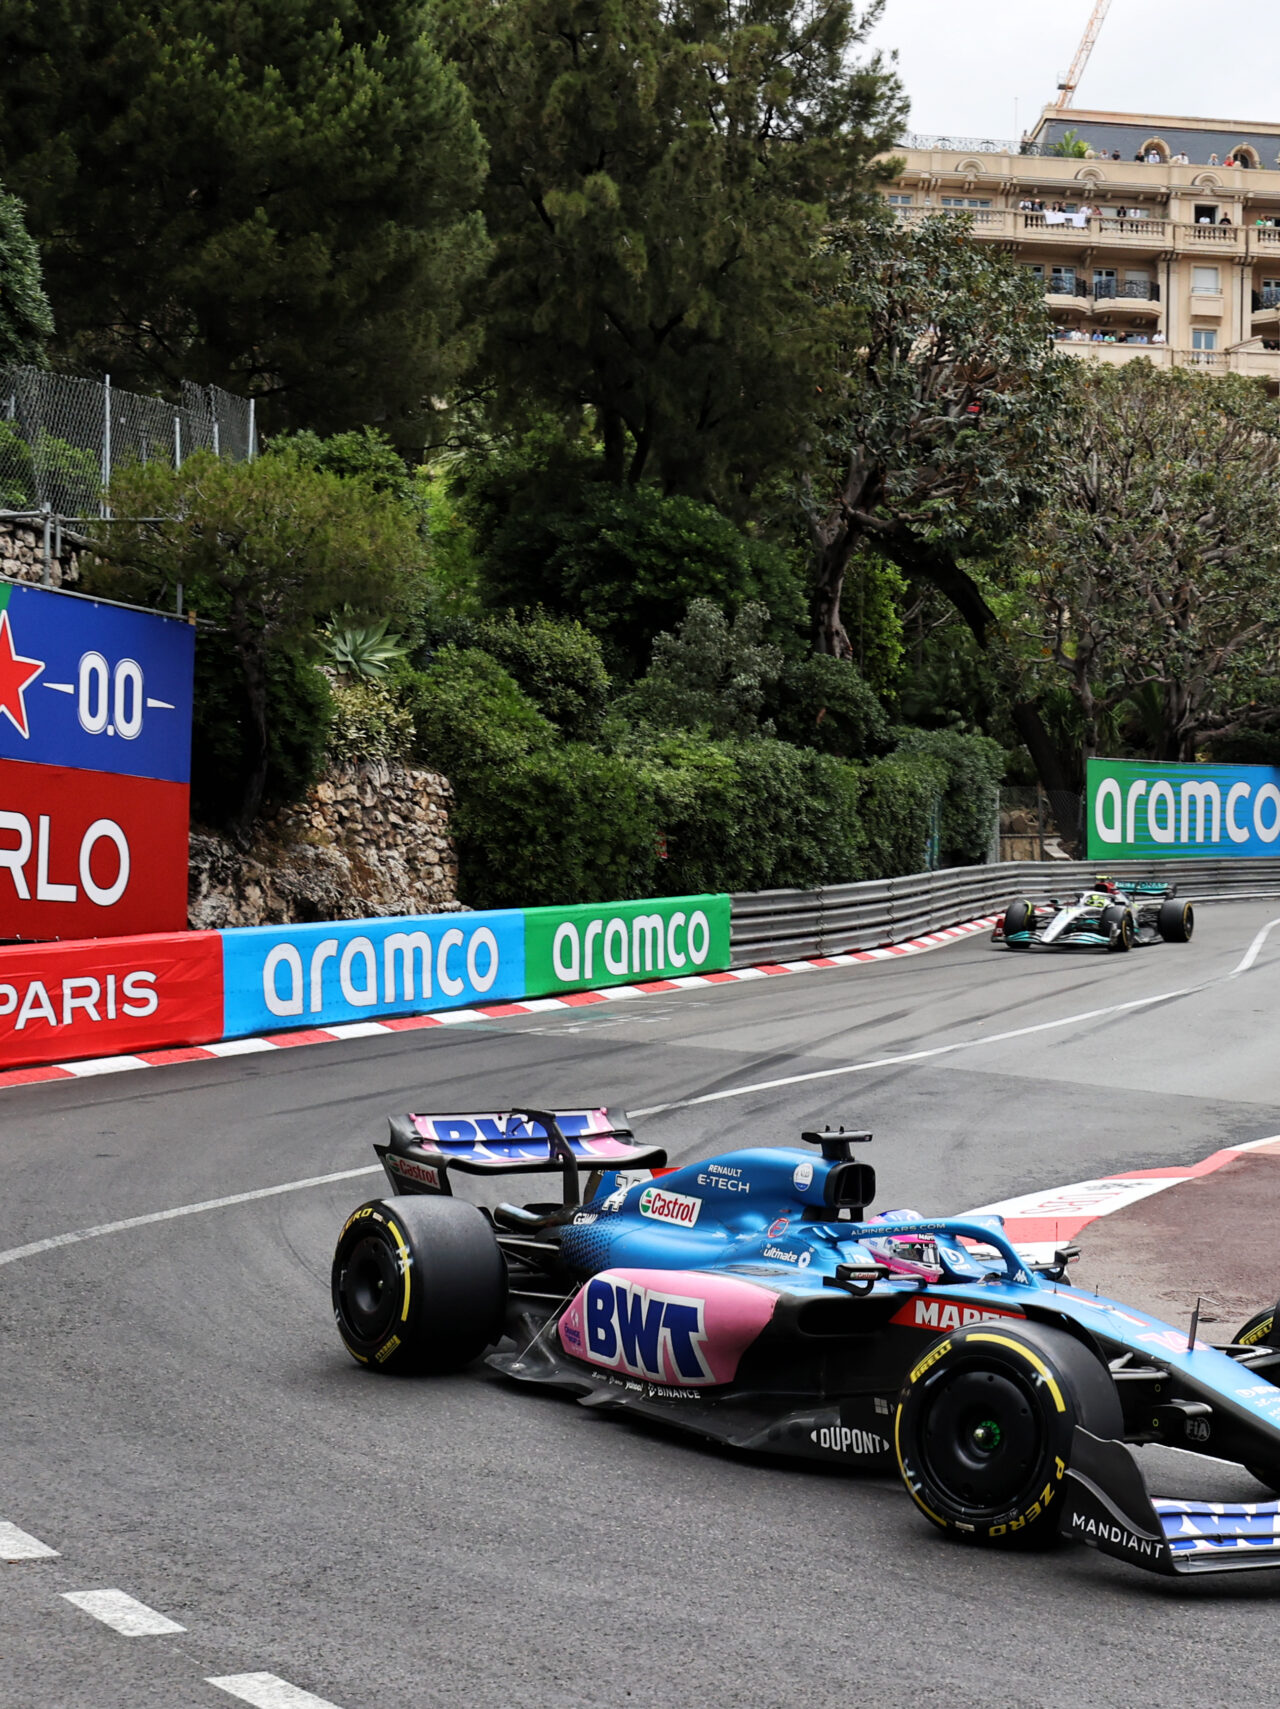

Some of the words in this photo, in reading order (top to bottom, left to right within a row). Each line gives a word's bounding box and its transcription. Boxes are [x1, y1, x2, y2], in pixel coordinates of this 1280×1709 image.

[552, 909, 711, 983] aramco
[263, 925, 499, 1018] aramco
[0, 970, 159, 1030] PARIS
[432, 1113, 600, 1161] BWT
[399, 1159, 439, 1187] Castrol
[697, 1174, 750, 1193] E-TECH
[708, 1164, 742, 1178] RENAULT
[650, 1192, 696, 1223] Castrol
[851, 1223, 947, 1236] ALPINECARS.COM
[763, 1244, 798, 1263] ultimate
[586, 1277, 708, 1379] BWT
[915, 1299, 1012, 1329] MAP
[910, 1339, 952, 1384] PIRELLI
[657, 1386, 701, 1399] BINANCE
[820, 1426, 881, 1454] DUPONT
[988, 1482, 1056, 1537] ZERO
[1072, 1512, 1164, 1559] MANDIANT
